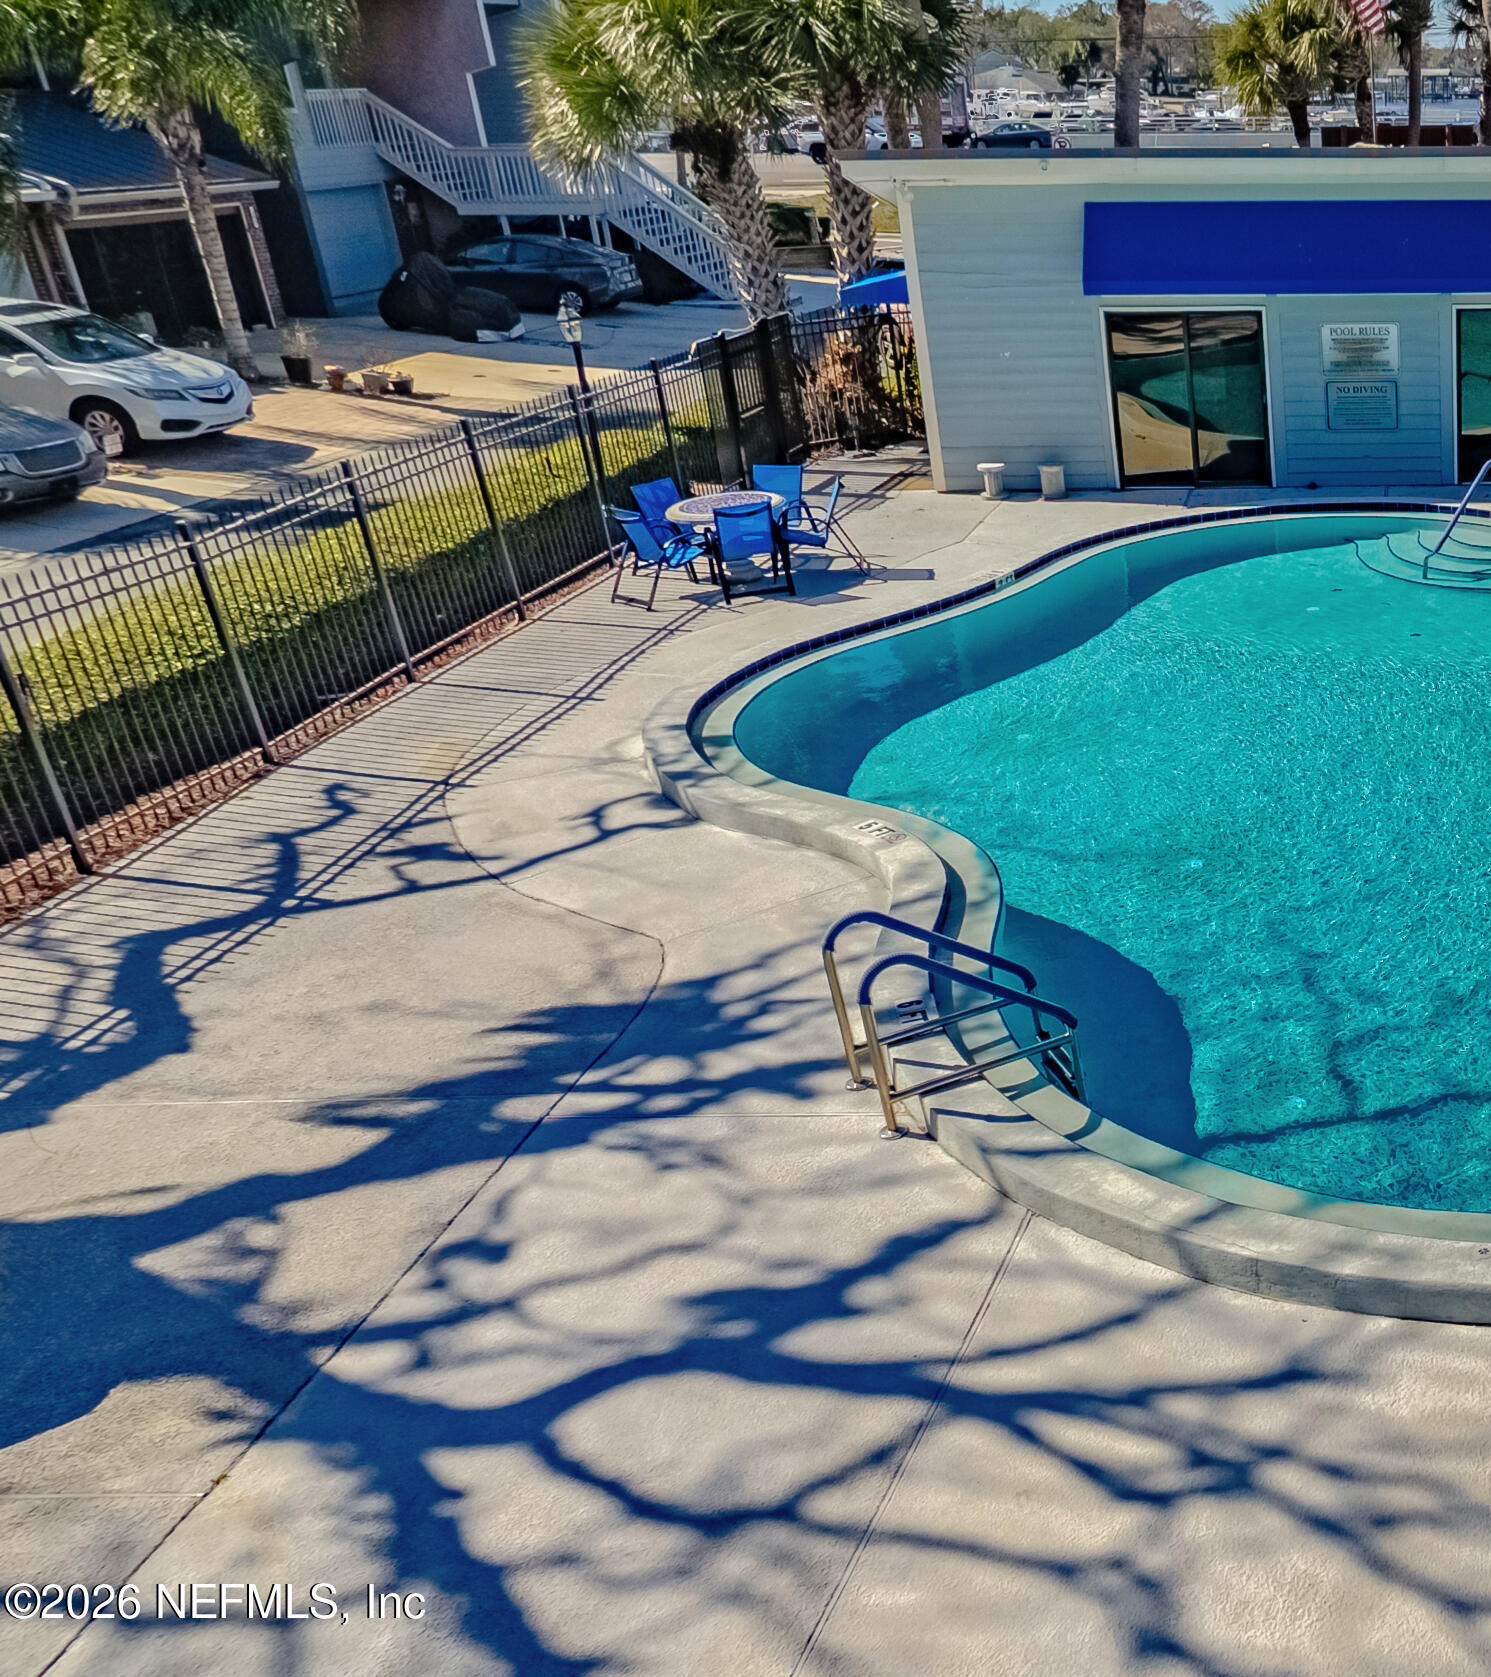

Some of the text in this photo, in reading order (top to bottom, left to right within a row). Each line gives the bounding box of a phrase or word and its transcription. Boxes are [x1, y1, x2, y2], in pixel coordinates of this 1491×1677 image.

[1329, 327, 1391, 336] POOL RULES
[1336, 385, 1388, 394] NO DIVING
[858, 821, 896, 837] 5 FT
[896, 999, 929, 1024] 6 FT
